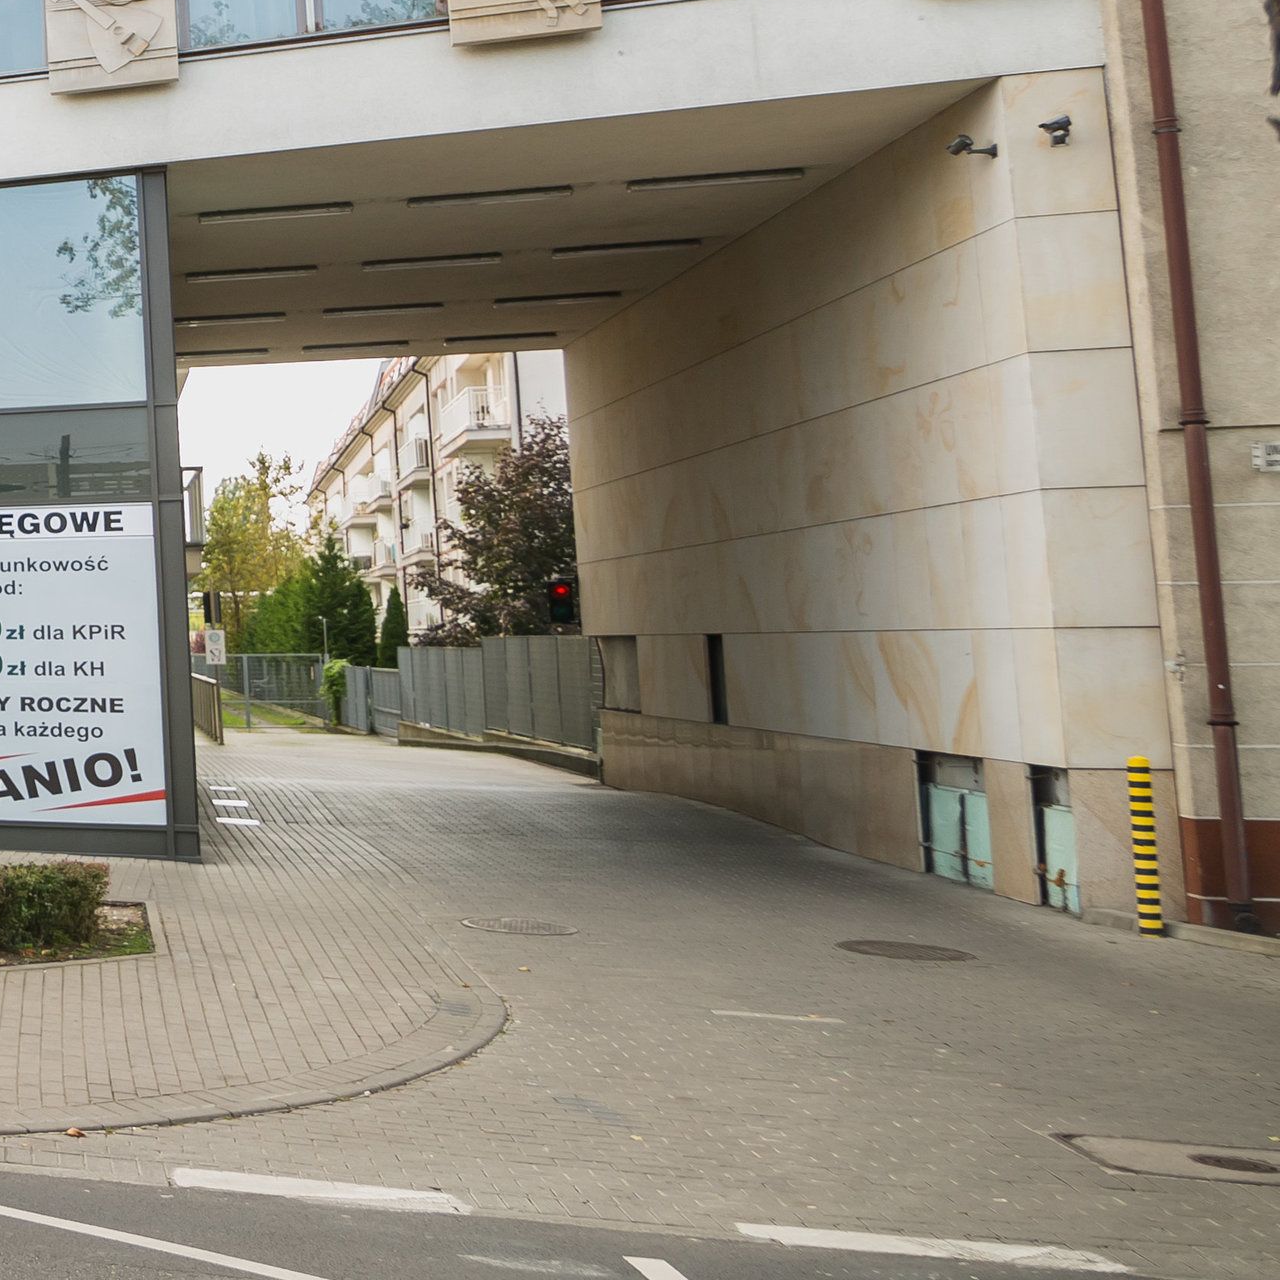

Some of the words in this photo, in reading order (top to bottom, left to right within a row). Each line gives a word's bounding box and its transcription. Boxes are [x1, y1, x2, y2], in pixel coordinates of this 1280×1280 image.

[6, 626, 25, 640] zł
[33, 624, 64, 640] dla
[73, 624, 126, 640] KPiR
[7, 662, 26, 676] zł
[34, 661, 65, 676] dla
[74, 662, 105, 676] KH
[20, 697, 124, 713] ROCZNE
[15, 722, 103, 742] każdego
